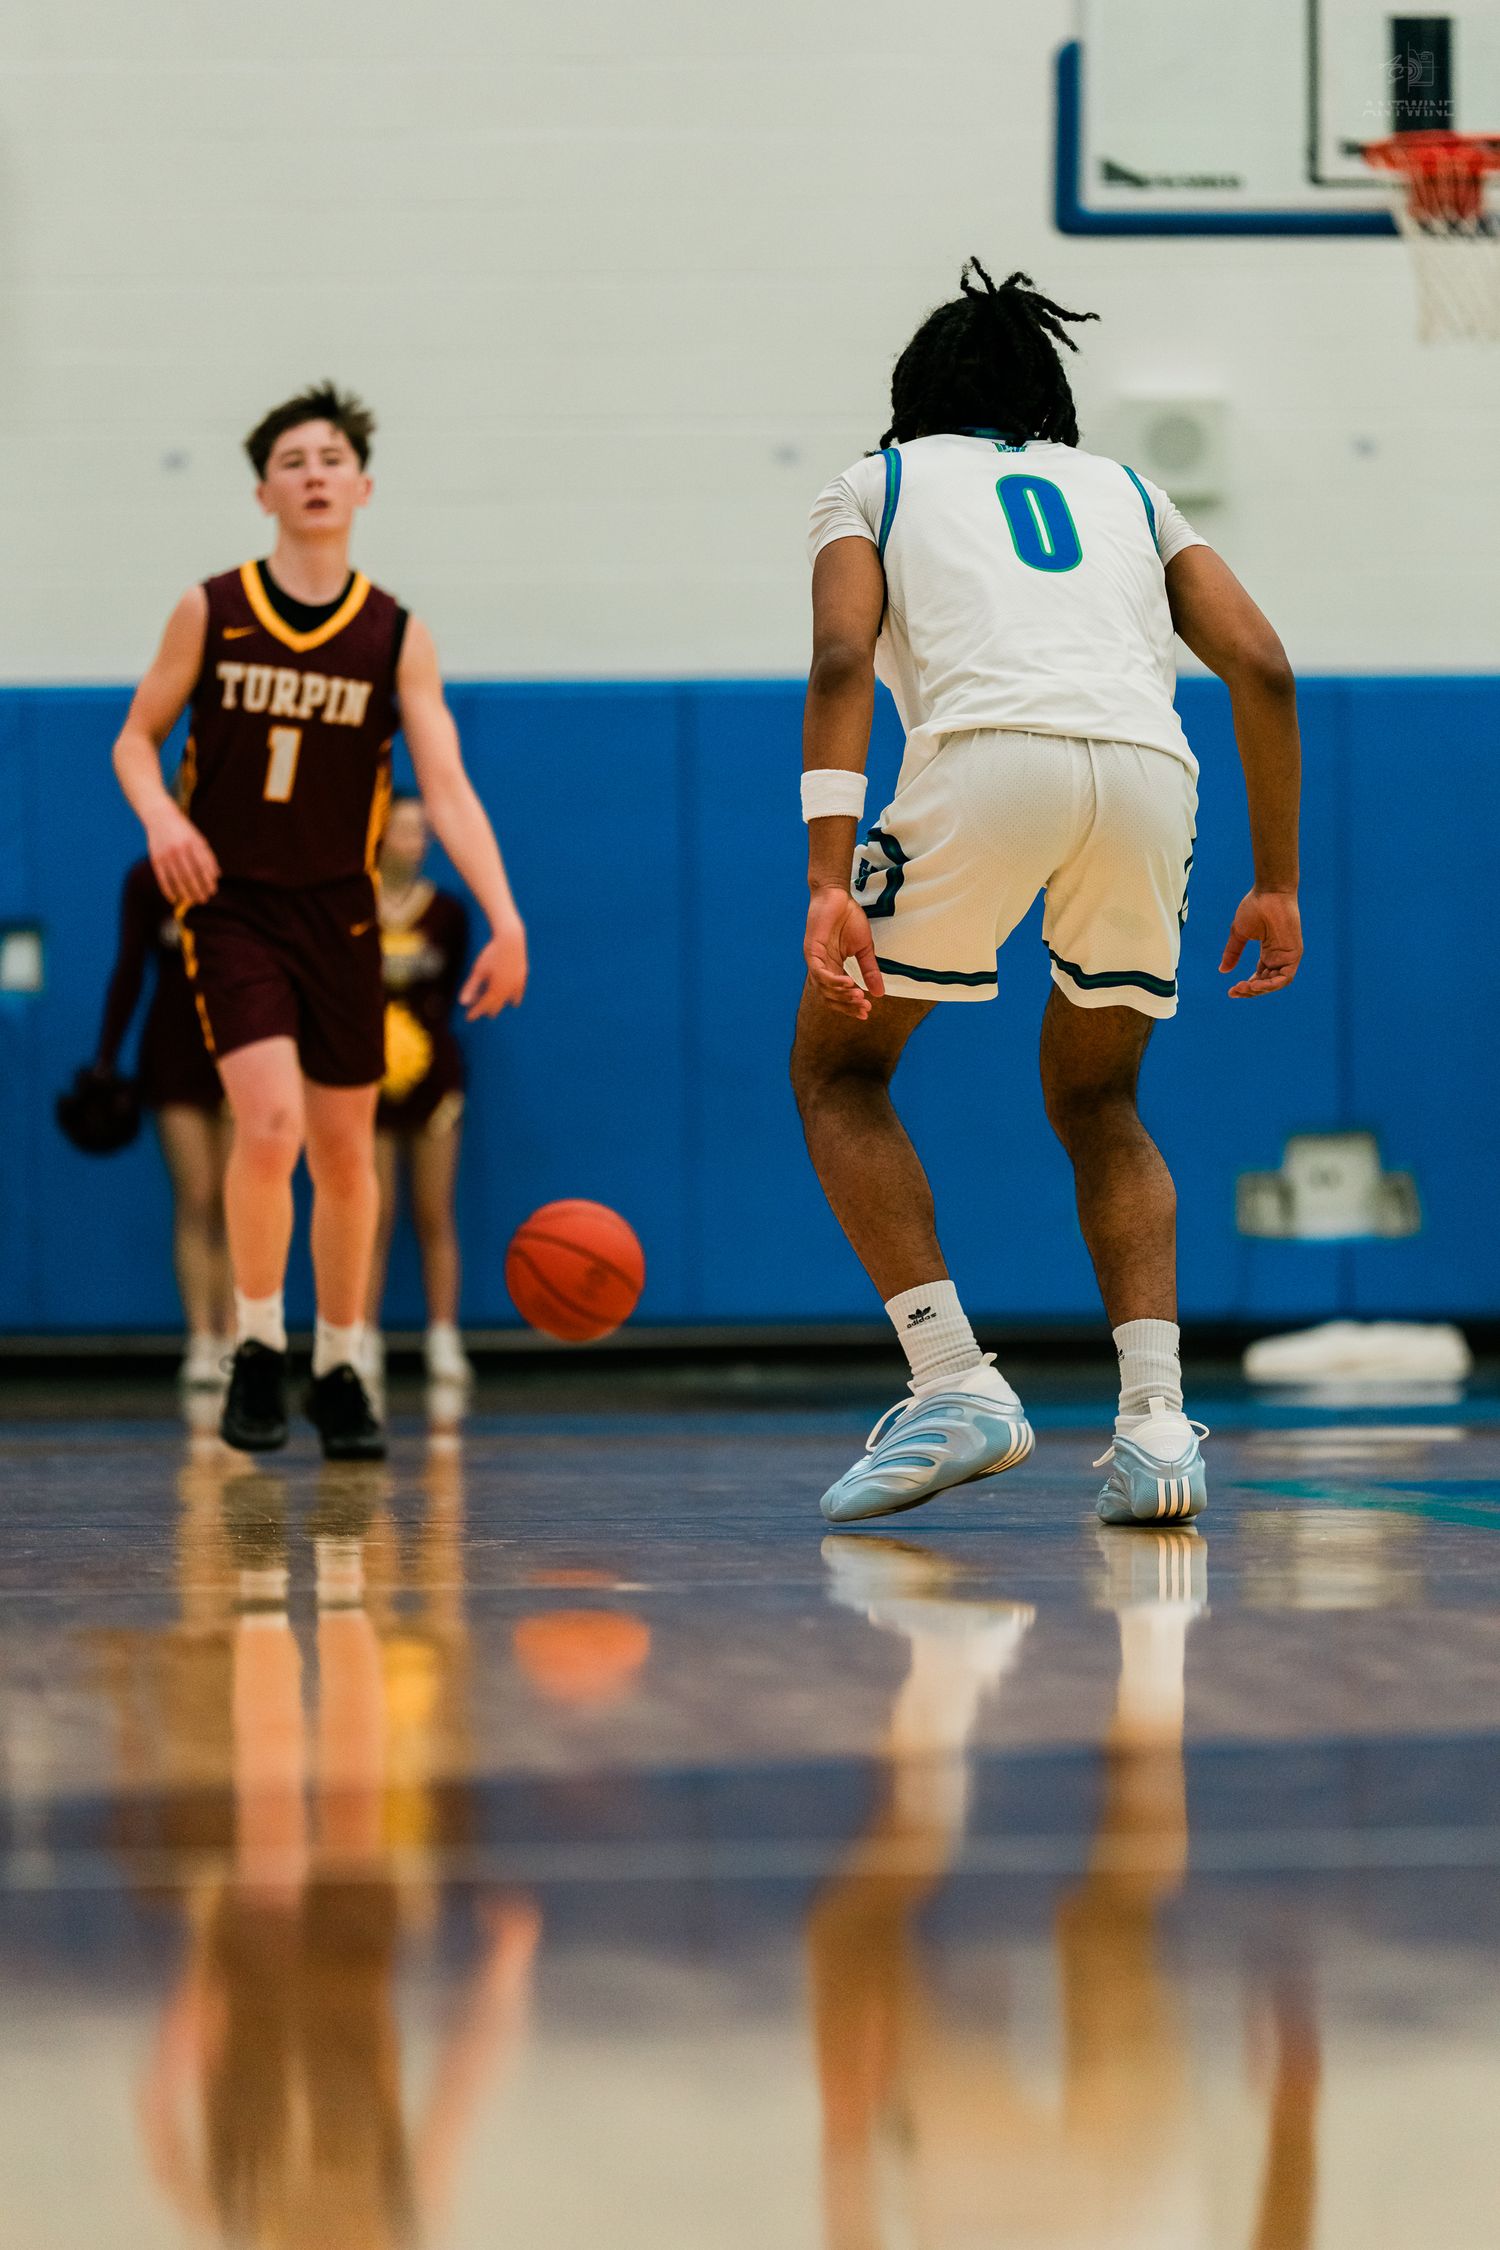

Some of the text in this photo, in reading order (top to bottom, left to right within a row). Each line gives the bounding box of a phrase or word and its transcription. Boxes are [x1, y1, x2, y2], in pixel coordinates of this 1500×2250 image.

[995, 473, 1083, 573] 0
[216, 661, 373, 727] TURPIN
[264, 725, 302, 804] 1
[906, 1312, 937, 1329] adidas
